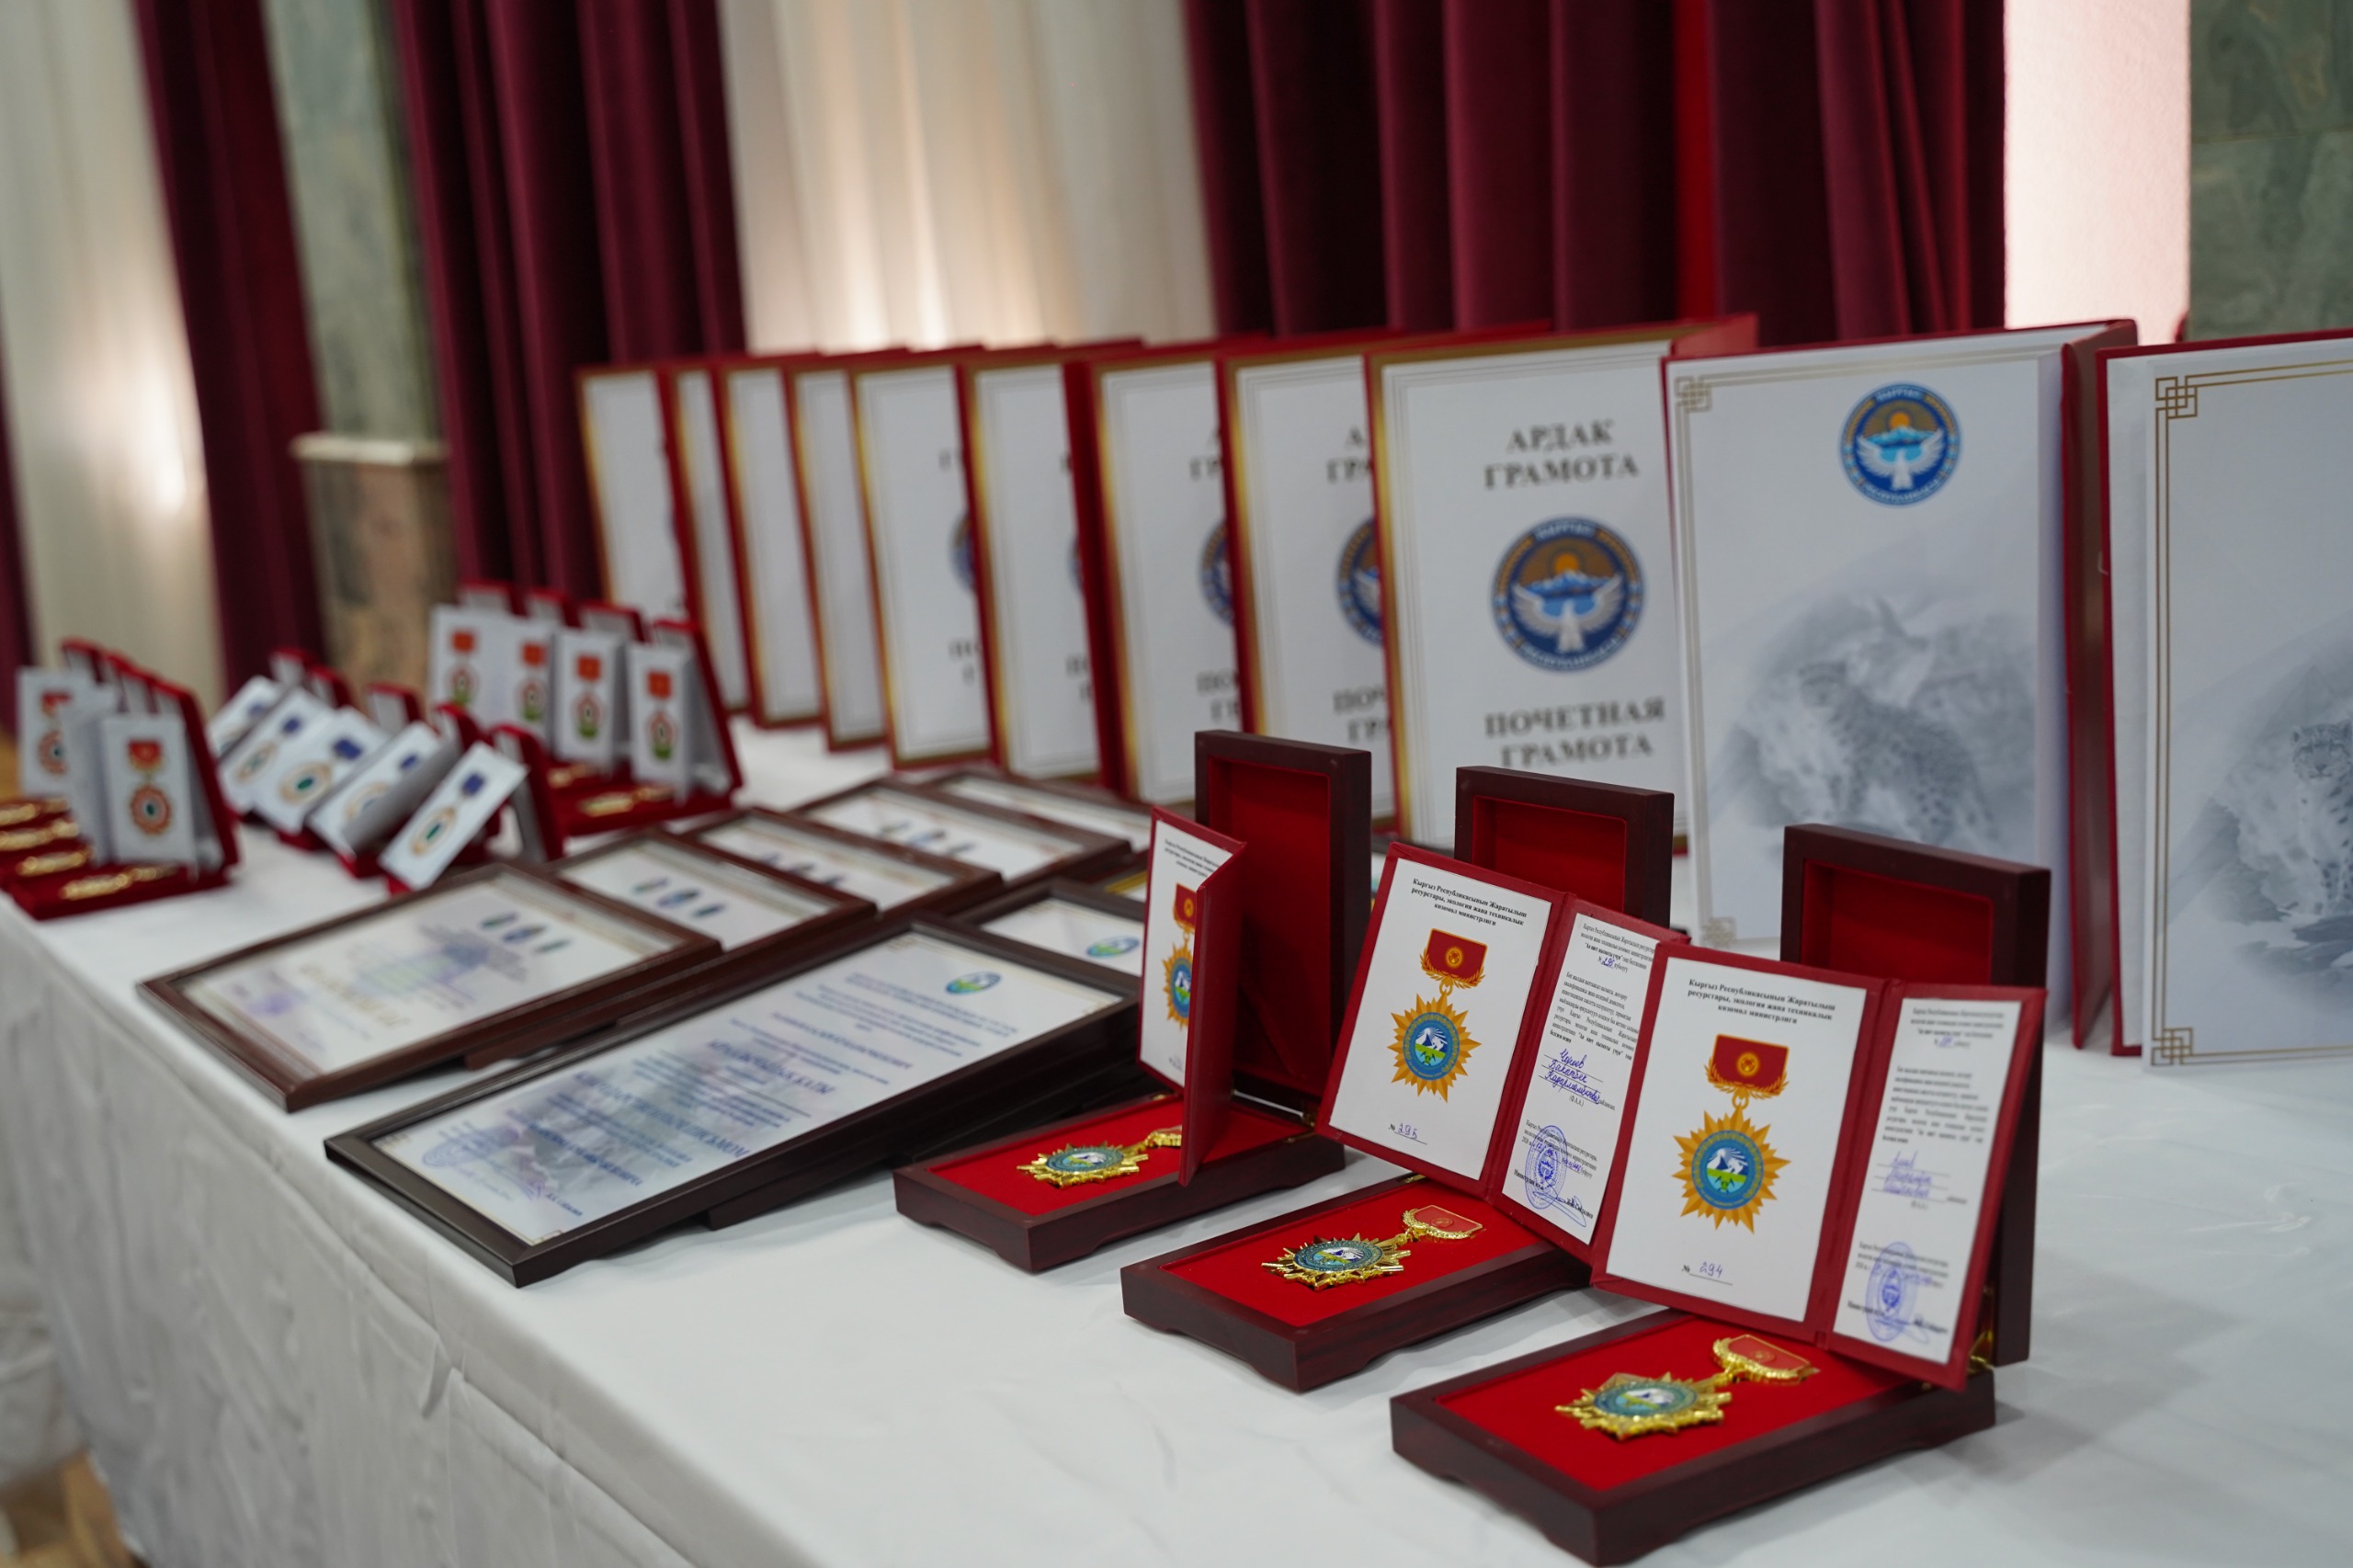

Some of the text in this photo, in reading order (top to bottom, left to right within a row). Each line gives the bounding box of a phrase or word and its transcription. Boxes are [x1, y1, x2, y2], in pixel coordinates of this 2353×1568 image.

[1506, 418, 1615, 454] АРДАК
[1483, 454, 1640, 490] ГРАМОТА
[1484, 696, 1665, 738] ПОЧЕТНАЯ
[1501, 733, 1654, 767] ГРАМОТА
[1688, 979, 1836, 1011] Кыргыз Республикасынын Жаратылыш
[1688, 989, 1833, 1020] ресурстары, экология жана техникалык
[1749, 1011, 1798, 1024] министрлиги
[1699, 1261, 1723, 1278] 294
